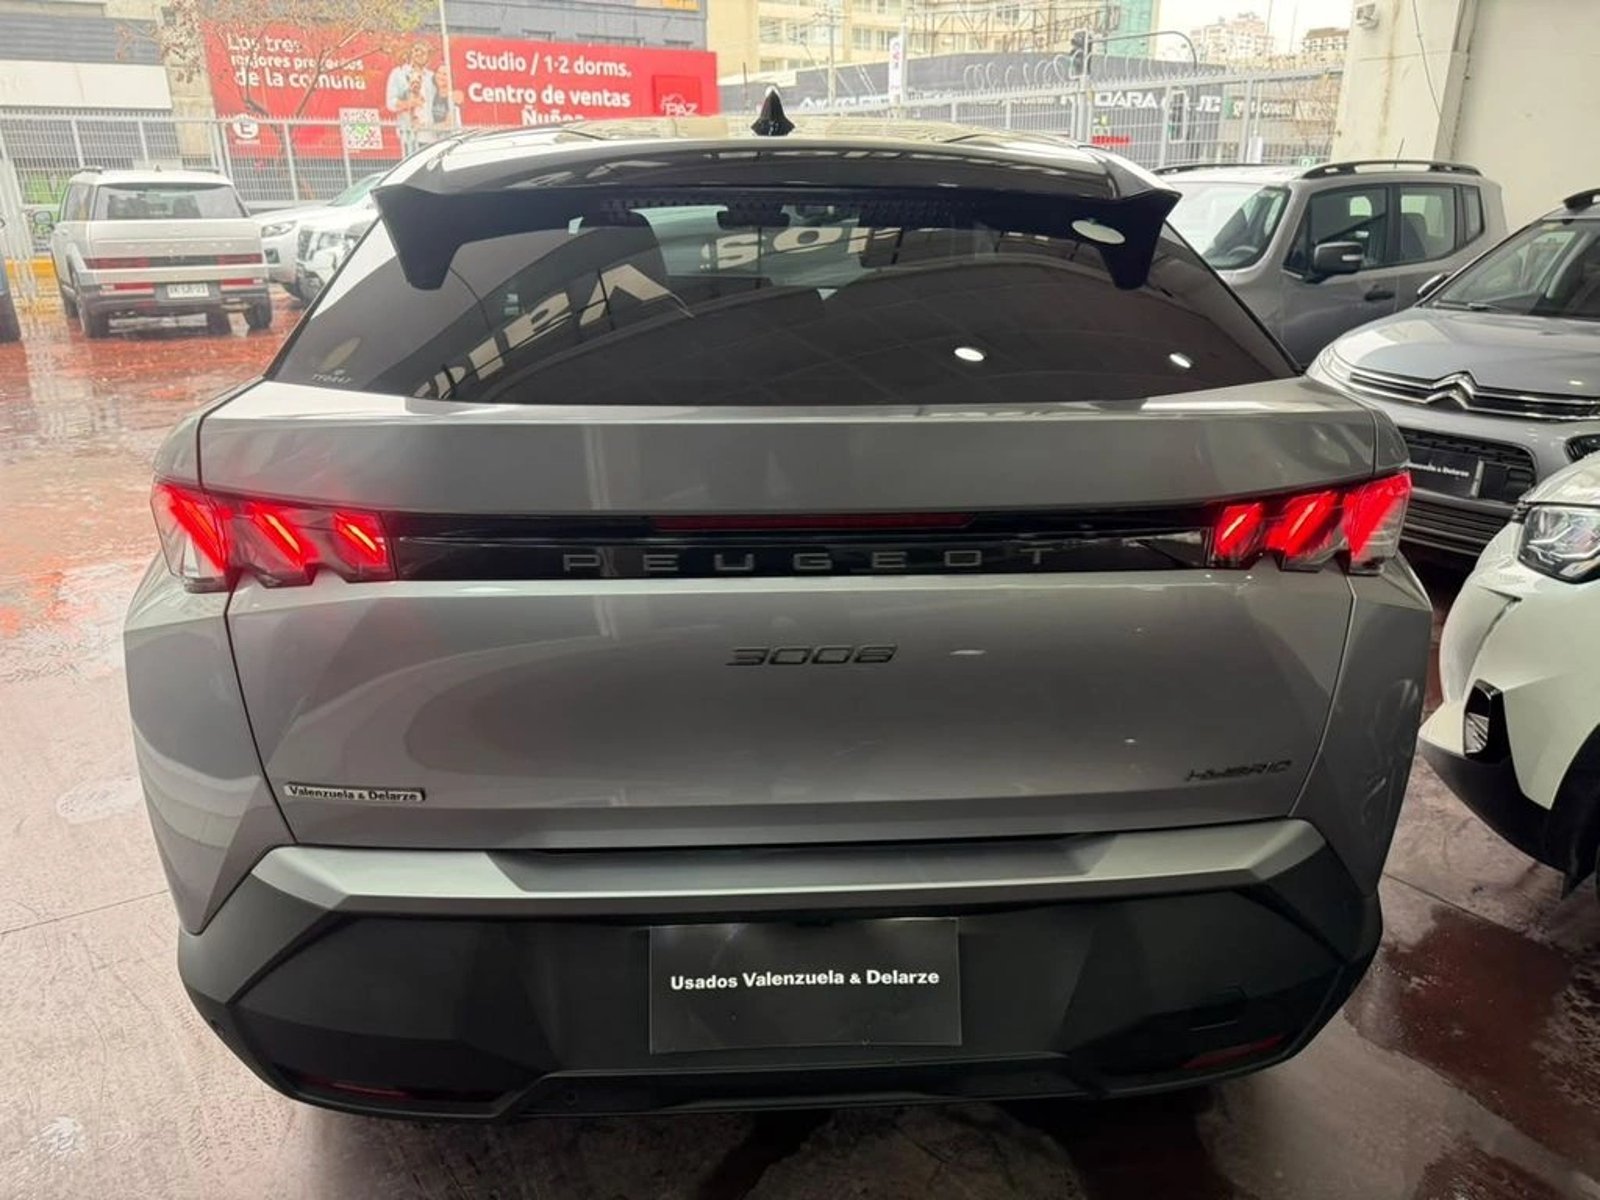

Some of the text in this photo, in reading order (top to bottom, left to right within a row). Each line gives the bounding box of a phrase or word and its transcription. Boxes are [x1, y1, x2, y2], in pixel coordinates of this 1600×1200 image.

[465, 51, 526, 71] Studio
[530, 52, 539, 76] /
[573, 55, 632, 78] dorms.
[235, 66, 260, 87] de
[265, 67, 284, 87] la
[468, 83, 631, 107] Centro de ventas
[563, 546, 1056, 573] PEUGEOT
[725, 644, 899, 667] 3008
[288, 785, 417, 802] Valenzuela & Delarze
[670, 968, 940, 990] Usados Valenzuela & Delarze
